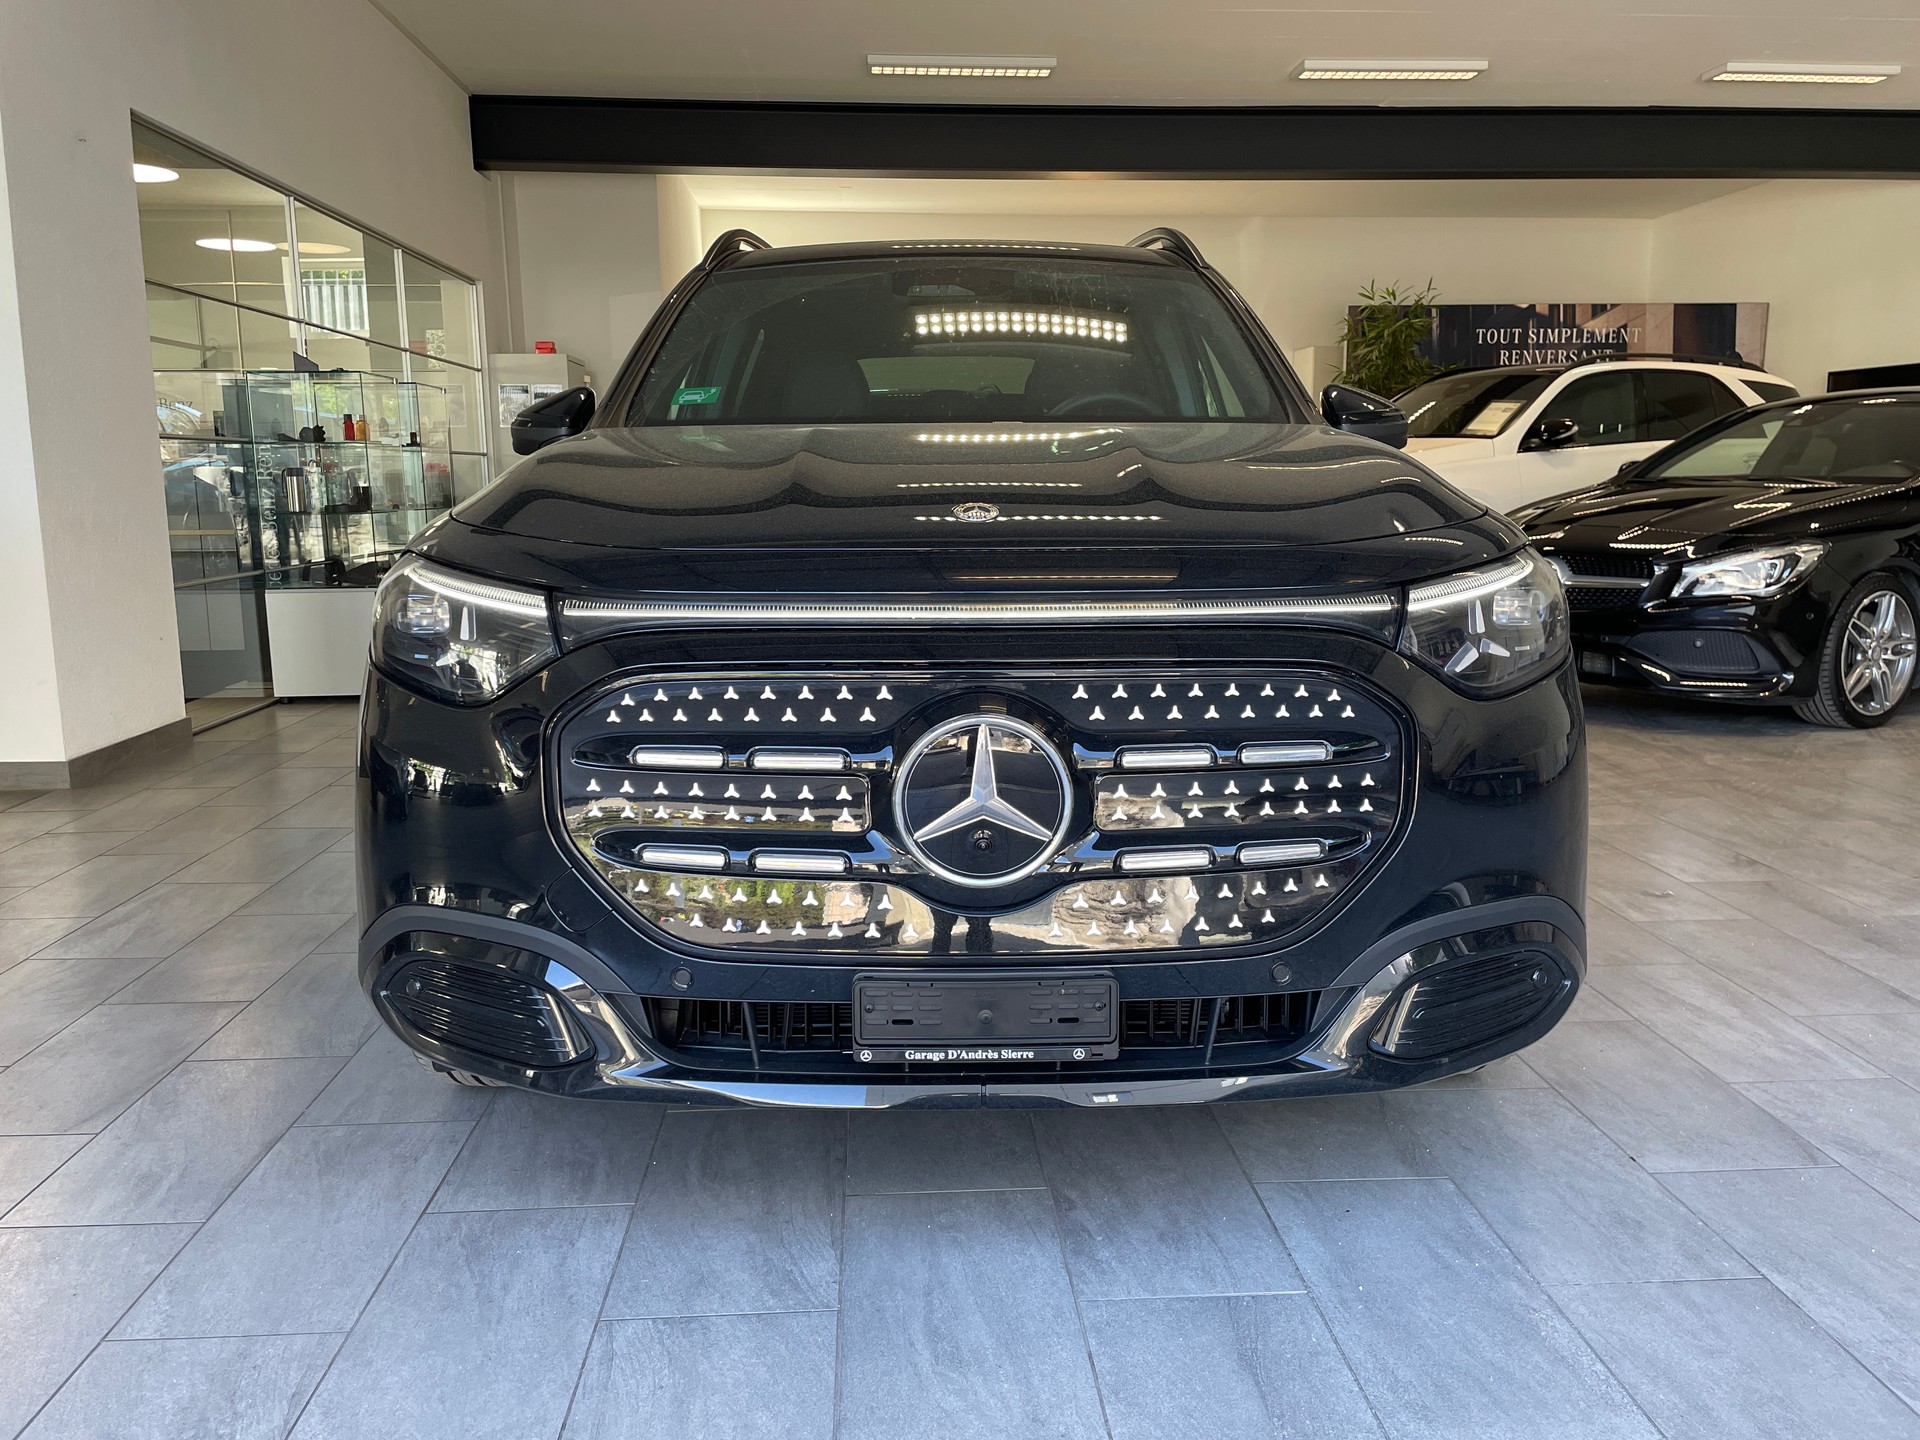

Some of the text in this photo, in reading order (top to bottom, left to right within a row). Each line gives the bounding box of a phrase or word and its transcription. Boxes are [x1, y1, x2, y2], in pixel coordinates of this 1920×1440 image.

[1476, 328, 1641, 344] TOUT SIMPLEMENT
[905, 1049, 1034, 1061] Garage D'Andrès Sierre
